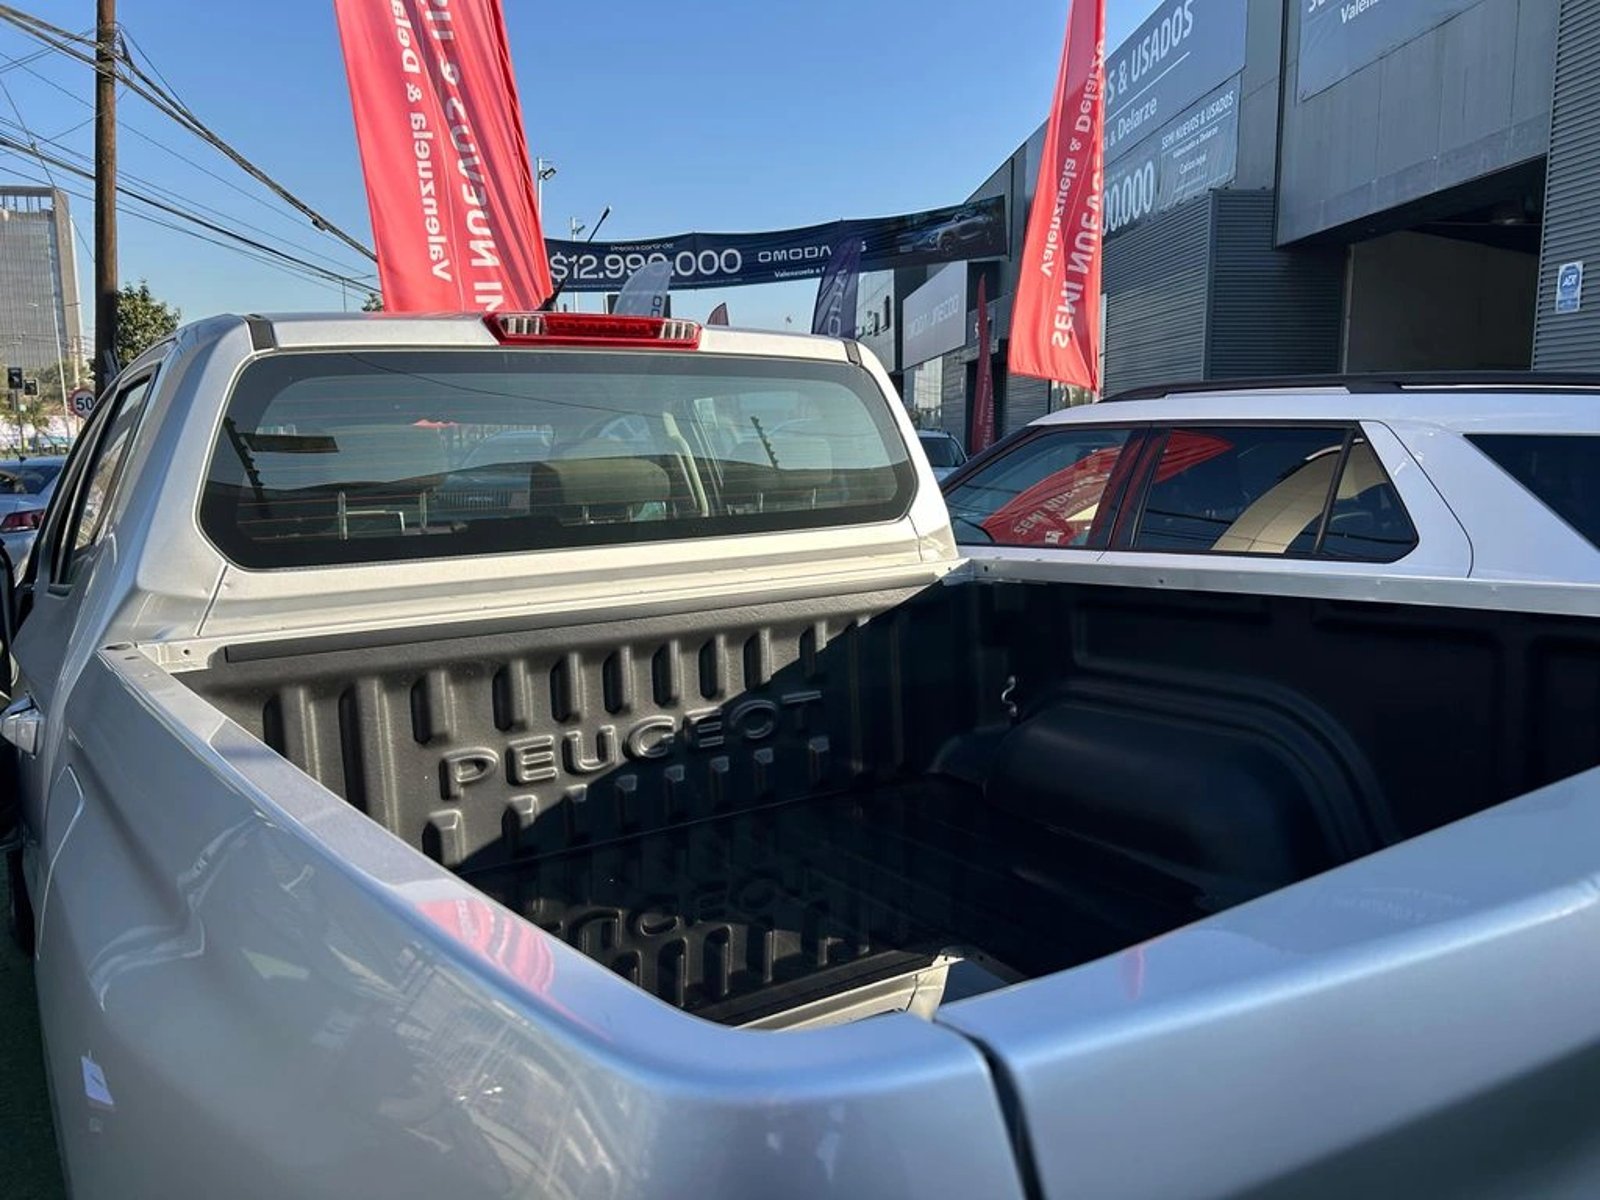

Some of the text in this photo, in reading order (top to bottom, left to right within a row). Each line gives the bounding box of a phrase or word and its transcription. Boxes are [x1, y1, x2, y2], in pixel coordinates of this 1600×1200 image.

[1118, 59, 1127, 94] &
[1131, 0, 1193, 82] USADOS
[1118, 97, 1157, 141] Delarze
[1102, 159, 1155, 237] 00.000
[758, 245, 832, 263] OMODA
[76, 396, 94, 412] 50
[440, 689, 822, 800] PEUGEOT
